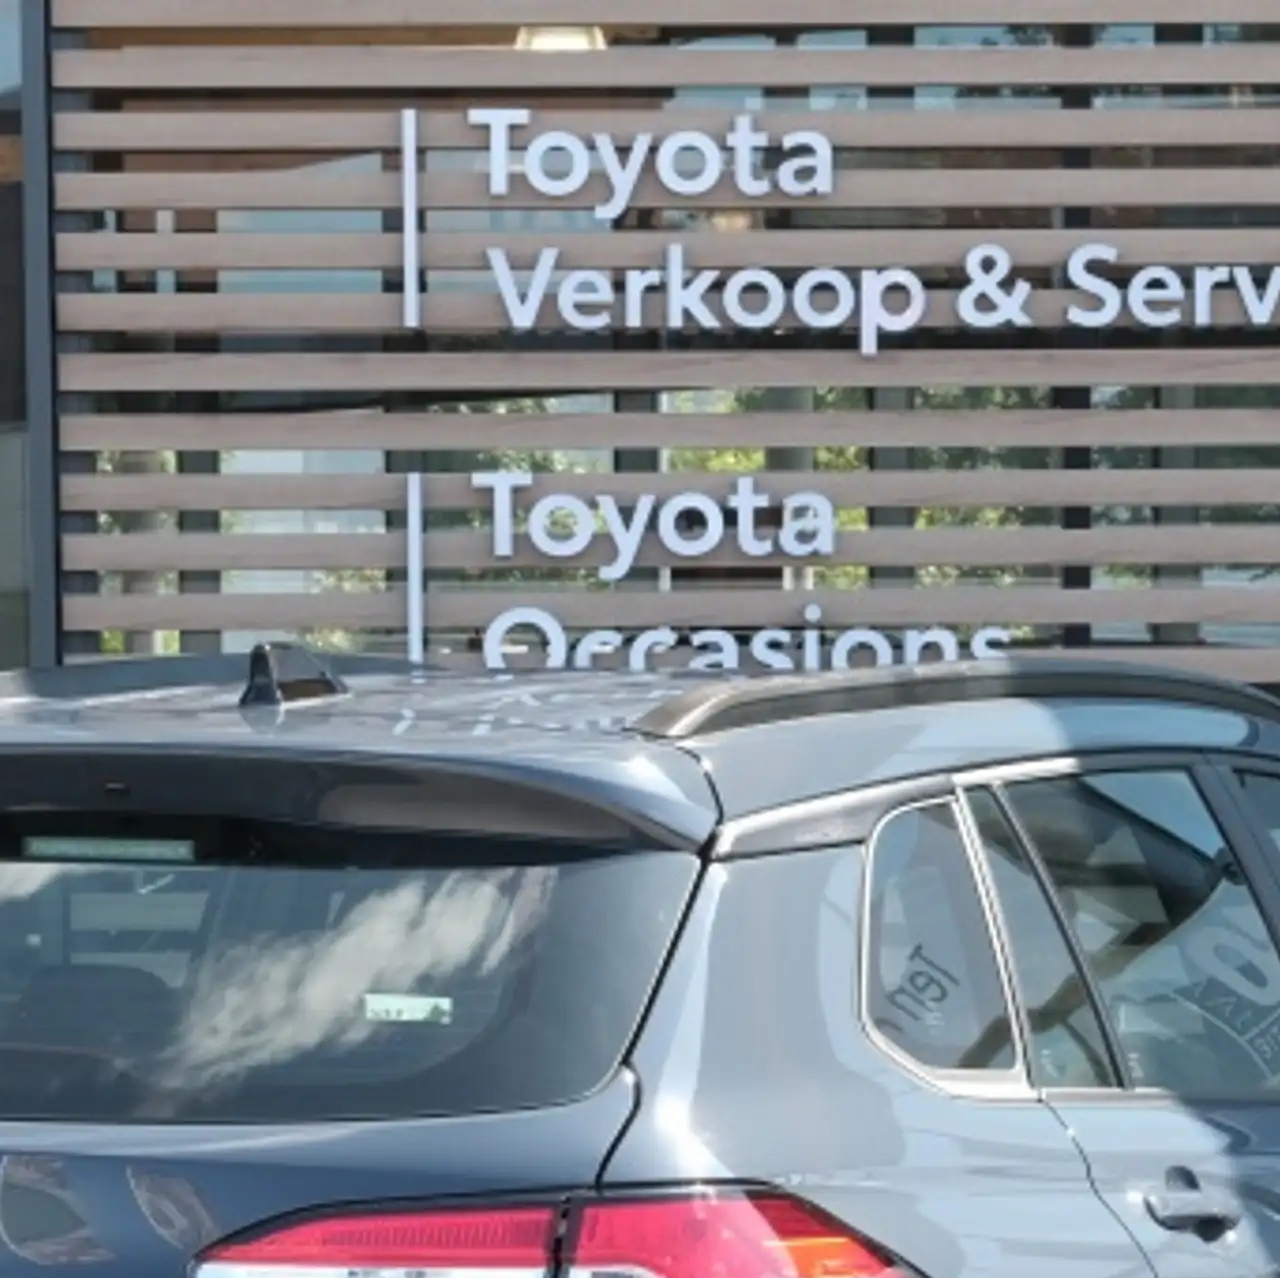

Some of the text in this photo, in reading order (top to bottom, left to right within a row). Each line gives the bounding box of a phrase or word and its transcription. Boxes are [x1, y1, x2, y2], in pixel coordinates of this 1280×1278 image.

[467, 107, 834, 219] Toyota
[486, 243, 927, 356] Verkoop
[956, 242, 1034, 328] &
[471, 471, 836, 581] Toyota
[483, 604, 1012, 671] Occasions
